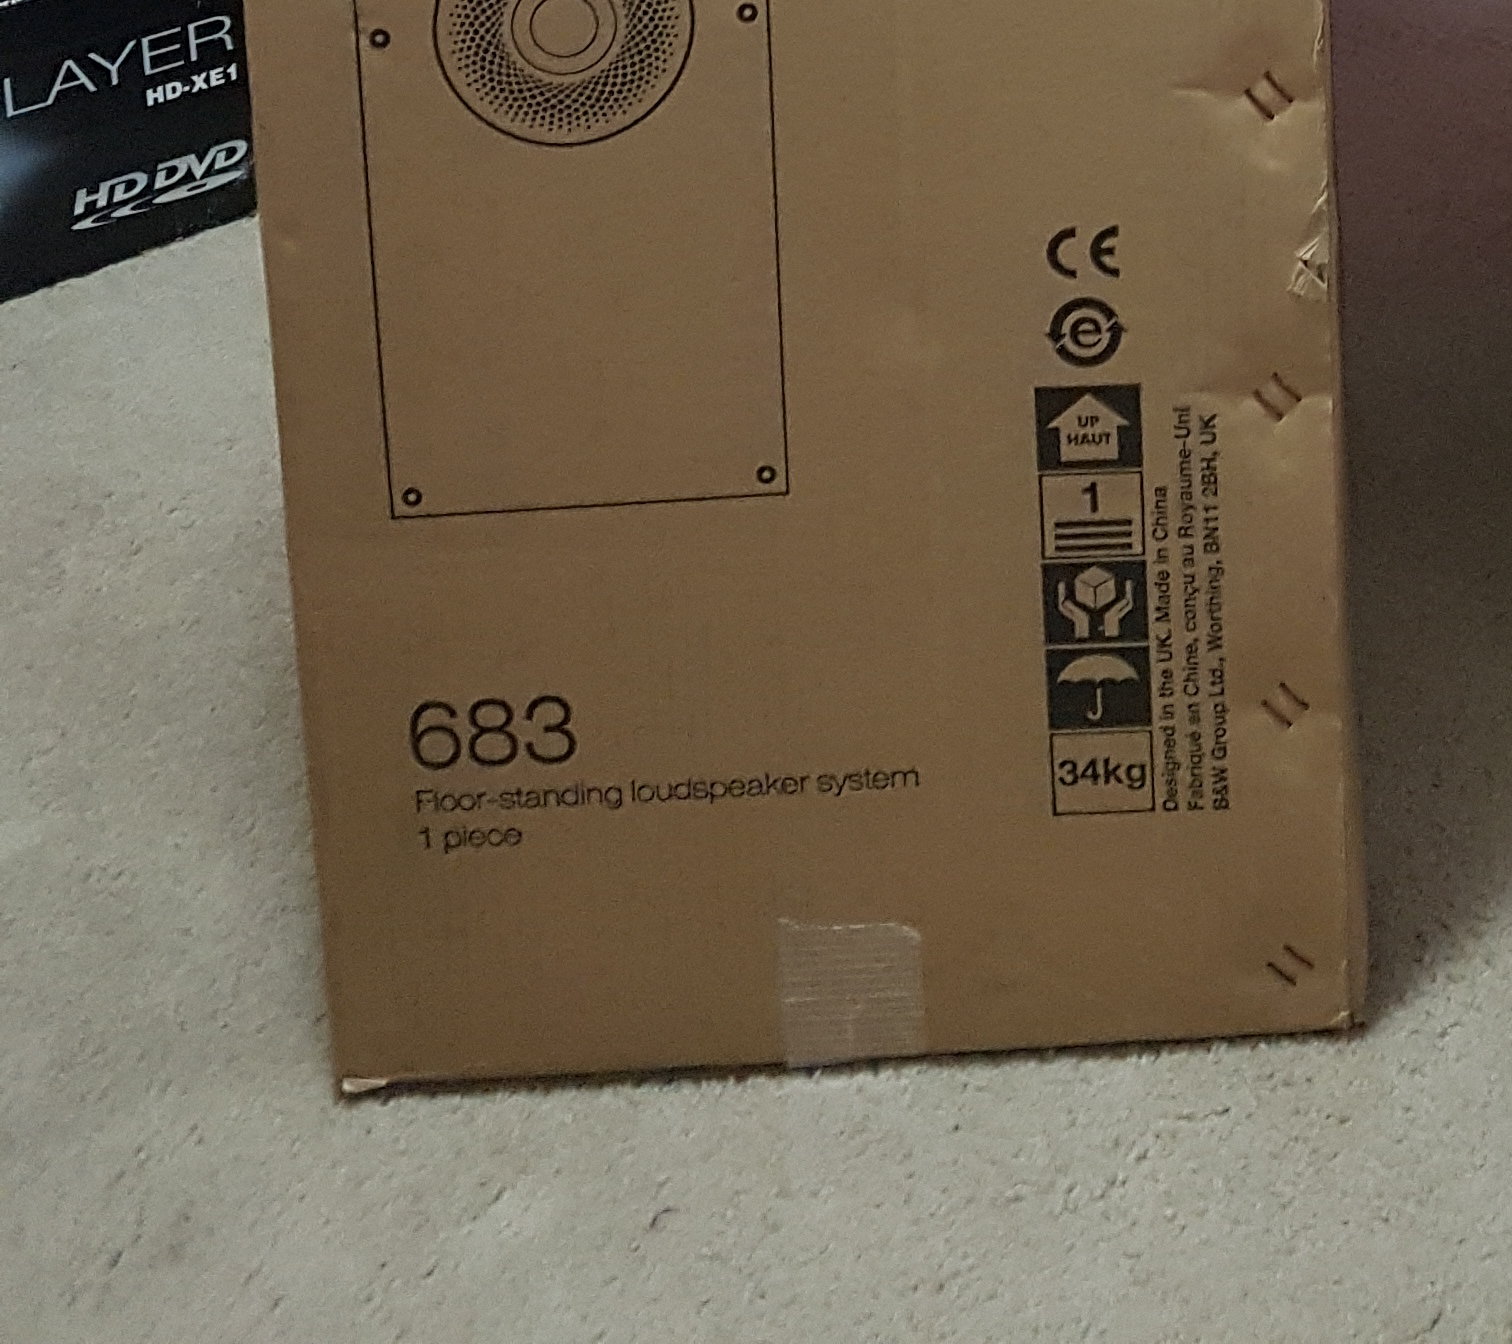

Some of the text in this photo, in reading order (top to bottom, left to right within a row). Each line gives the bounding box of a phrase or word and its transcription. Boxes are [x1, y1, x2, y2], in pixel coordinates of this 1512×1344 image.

[145, 62, 239, 108] HD-XE1
[74, 138, 249, 217] HD DVD
[1066, 432, 1111, 446] HAUT
[1077, 415, 1100, 428] UP
[1198, 413, 1217, 446] UK
[1172, 405, 1198, 540] Royaume-Uni
[1081, 481, 1099, 513] 1
[1151, 485, 1169, 542] China
[1202, 504, 1220, 555] BN11
[1152, 548, 1169, 564] in
[1181, 544, 1195, 569] au
[1154, 571, 1171, 623] Made
[1157, 669, 1174, 698] the
[408, 695, 578, 772] 683
[415, 765, 921, 812] Floor-standing loudspeaker system
[1057, 755, 1147, 790] 34kg
[418, 824, 524, 854] 1 piece
